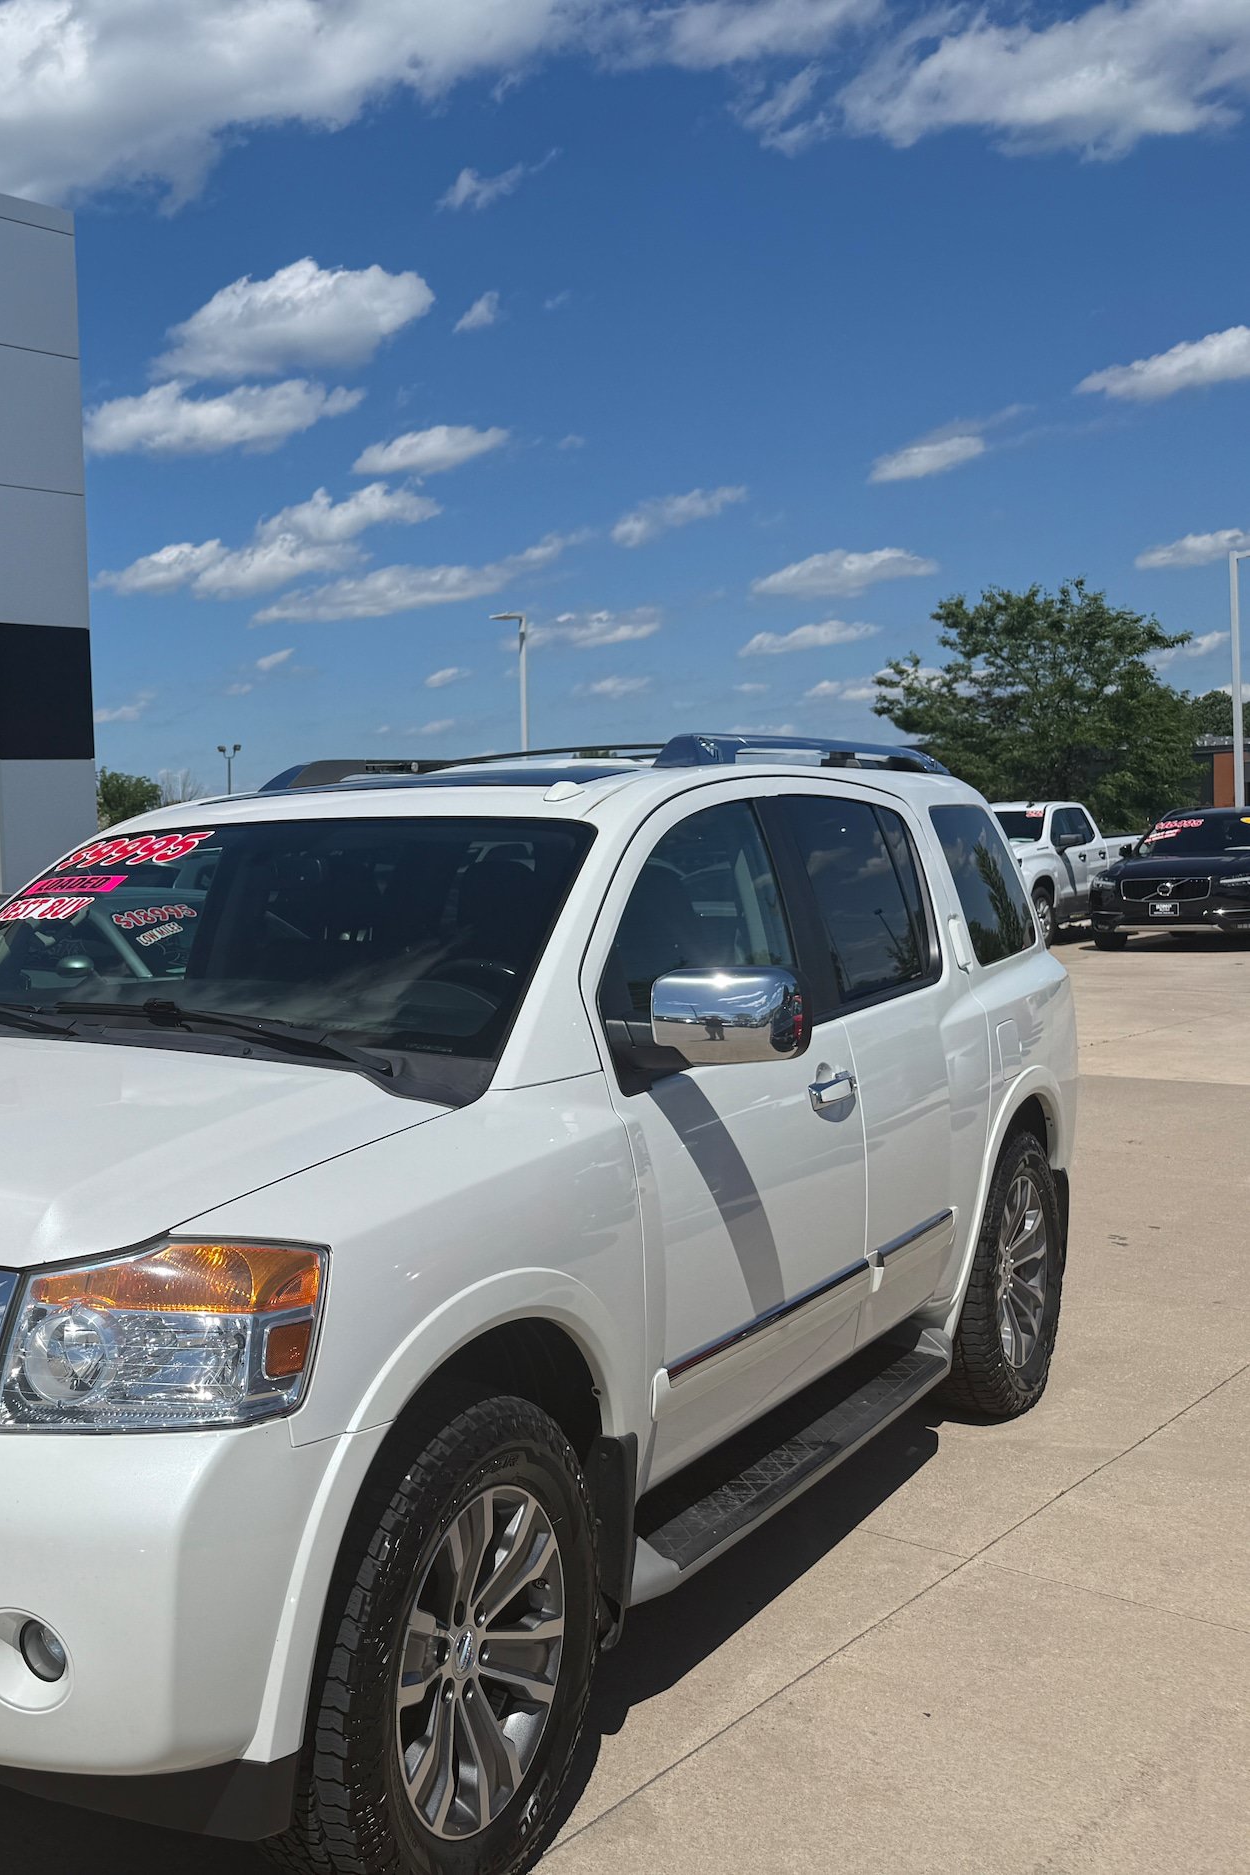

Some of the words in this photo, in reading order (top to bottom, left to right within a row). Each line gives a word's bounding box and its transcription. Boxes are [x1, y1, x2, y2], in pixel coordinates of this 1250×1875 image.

[54, 831, 216, 872] $9995
[37, 877, 110, 891] LOADED
[36, 897, 95, 919] BUY
[112, 904, 197, 929] $18995
[136, 929, 160, 946] LOW
